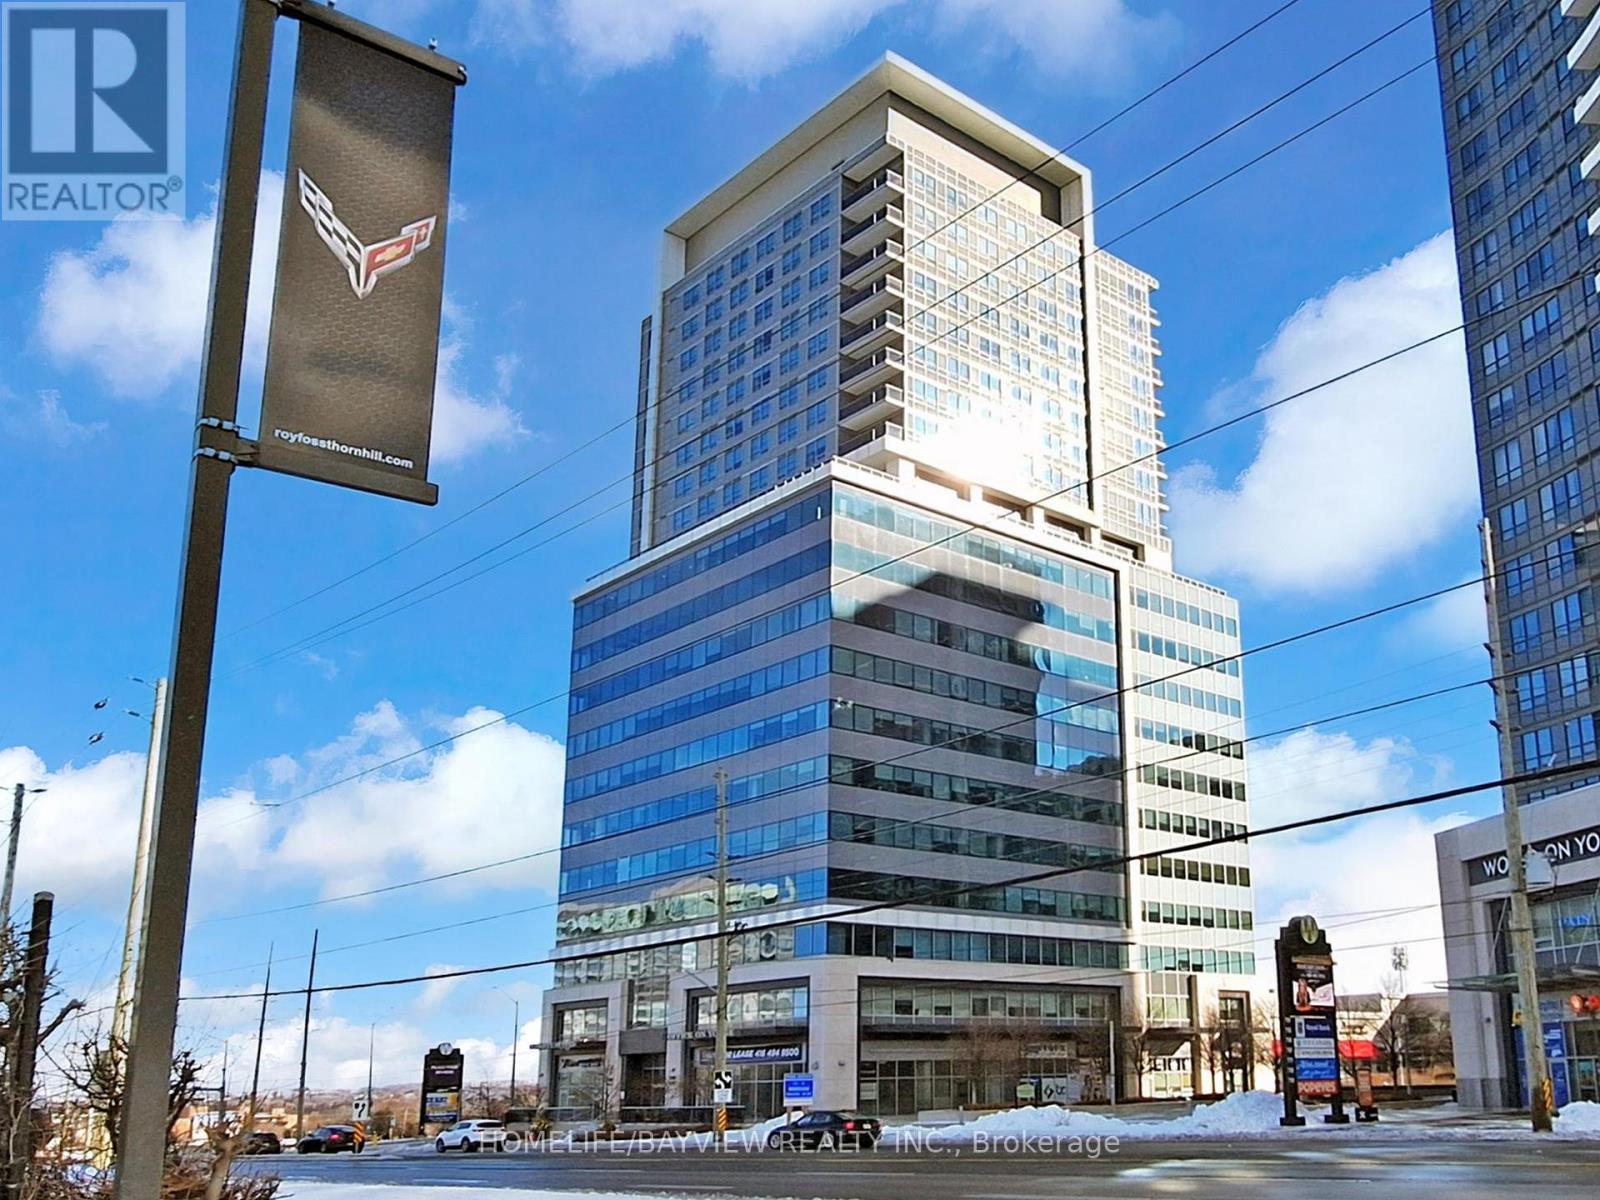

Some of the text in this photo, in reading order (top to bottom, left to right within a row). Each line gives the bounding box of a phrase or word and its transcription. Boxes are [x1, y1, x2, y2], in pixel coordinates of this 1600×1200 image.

[274, 428, 414, 469] royfossthornhill.com
[1545, 840, 1571, 862] ON
[732, 1049, 754, 1059] LEASE
